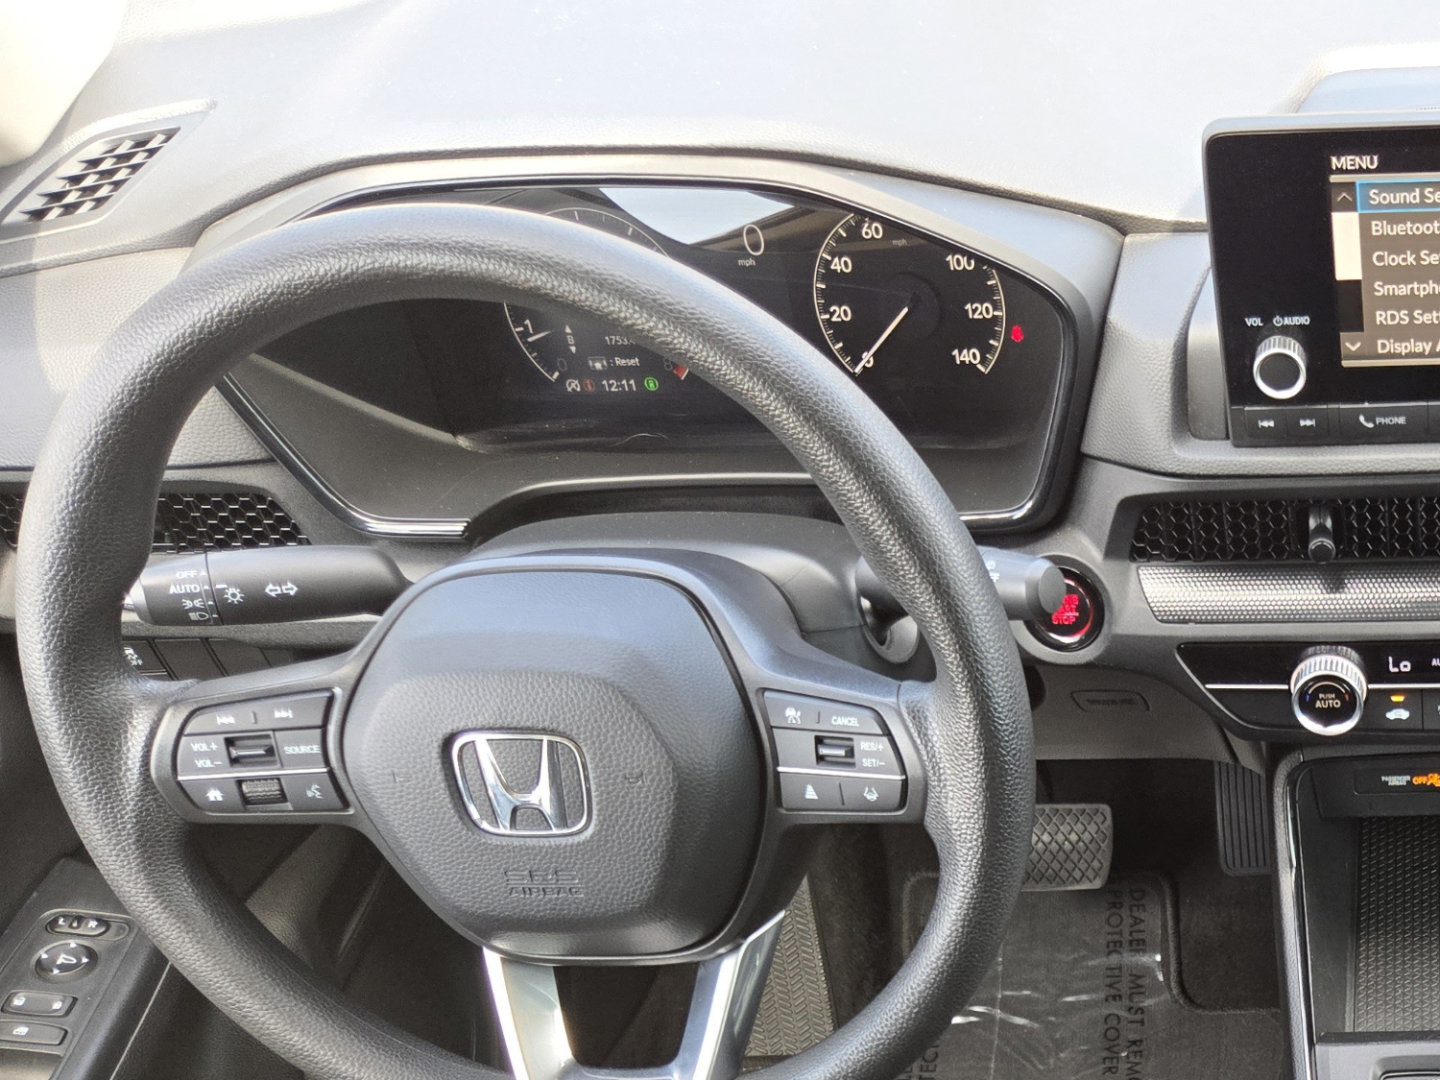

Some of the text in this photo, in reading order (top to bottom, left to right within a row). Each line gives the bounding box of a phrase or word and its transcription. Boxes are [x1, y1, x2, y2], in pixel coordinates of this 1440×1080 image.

[1331, 154, 1379, 171] MENU
[1369, 186, 1420, 205] Sound
[742, 222, 765, 257] 0
[860, 221, 884, 240] 60
[737, 257, 757, 268] mph
[829, 255, 853, 274] 40
[944, 253, 976, 272] 100
[1372, 249, 1417, 267] Clock
[828, 304, 853, 323] 20
[963, 302, 994, 320] 120
[1375, 308, 1410, 326] RDS
[1245, 315, 1311, 327] VOL AUDIO
[1376, 337, 1433, 357] Display
[951, 347, 982, 366] 140
[601, 378, 638, 393] 12:11
[1375, 416, 1407, 426] PHONE
[176, 570, 199, 580] OFF
[168, 584, 201, 595] AUTO
[1315, 699, 1341, 709] AUTO
[831, 715, 860, 728] CANCEL
[283, 744, 321, 755] SOURCE
[1127, 973, 1147, 1027] MUST
[1102, 1012, 1122, 1077] COVER
